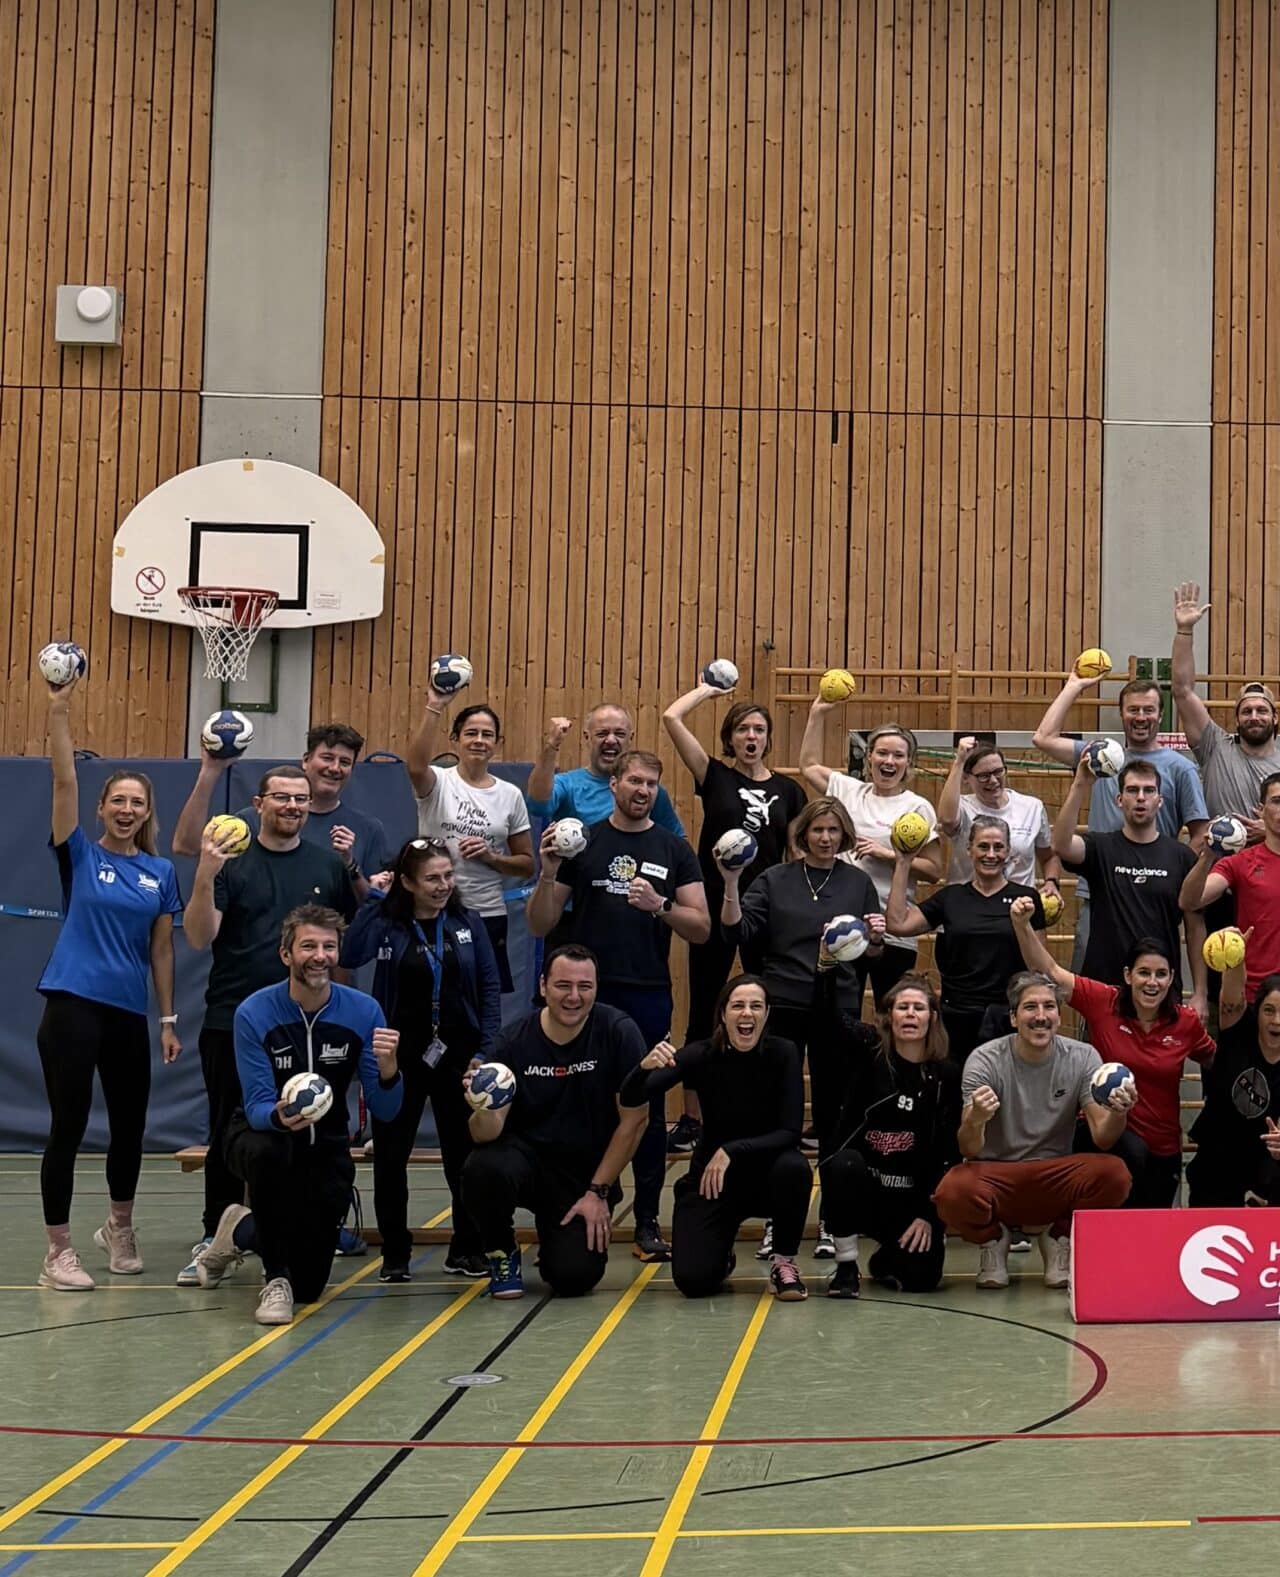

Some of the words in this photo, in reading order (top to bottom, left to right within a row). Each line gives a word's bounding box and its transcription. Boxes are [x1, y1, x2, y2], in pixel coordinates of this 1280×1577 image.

[1132, 867, 1168, 877] balance
[524, 1065, 554, 1077] JACK
[897, 1094, 914, 1111] 93
